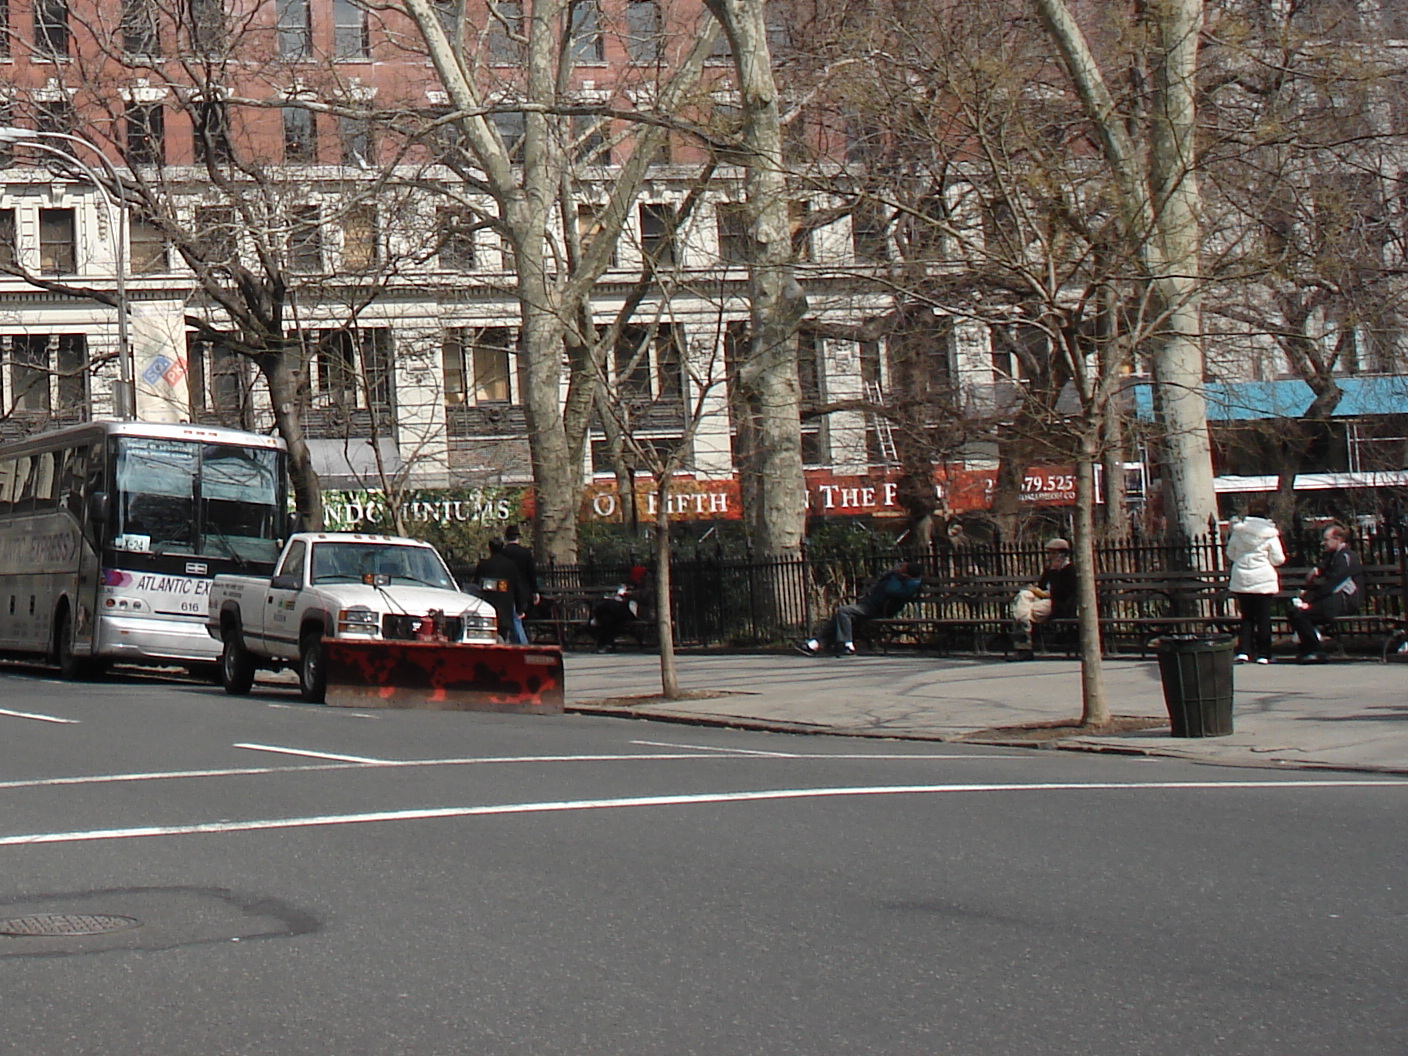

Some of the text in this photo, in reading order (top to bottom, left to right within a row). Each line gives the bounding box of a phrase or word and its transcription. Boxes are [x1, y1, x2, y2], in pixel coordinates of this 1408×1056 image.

[819, 485, 876, 508] THE
[136, 575, 192, 594] ATLANTIC
[181, 602, 199, 612] 616
